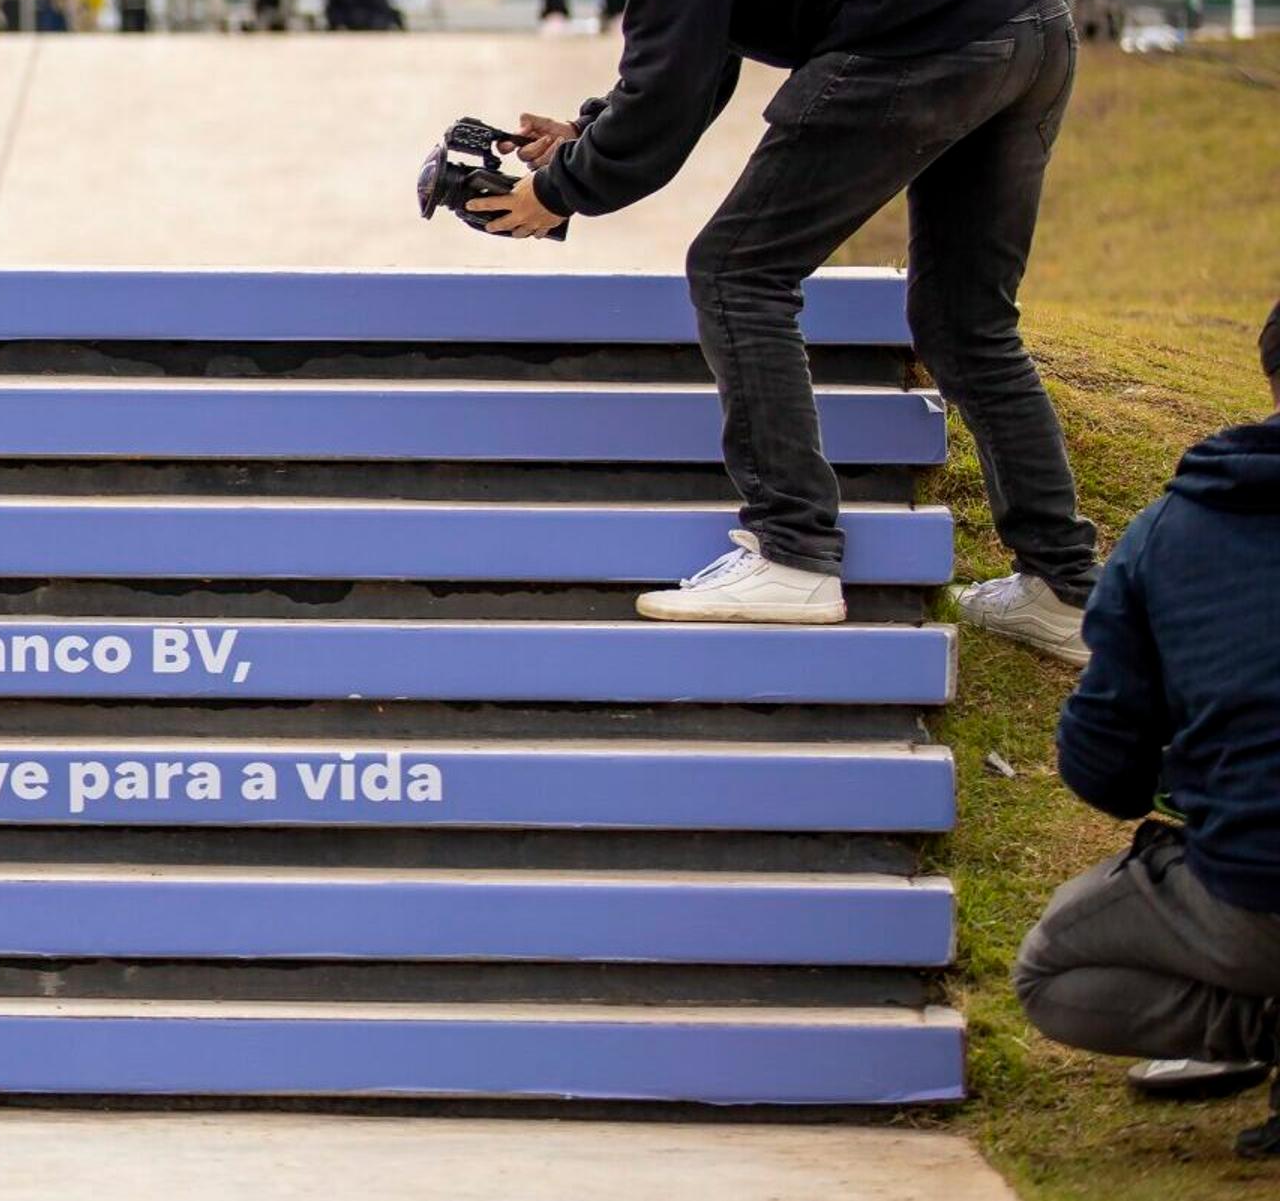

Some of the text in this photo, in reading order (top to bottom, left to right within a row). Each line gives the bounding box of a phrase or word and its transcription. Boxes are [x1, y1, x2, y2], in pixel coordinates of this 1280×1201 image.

[152, 627, 251, 683] BV,
[69, 761, 221, 813] para
[241, 762, 277, 801] a
[295, 752, 443, 802] vida
